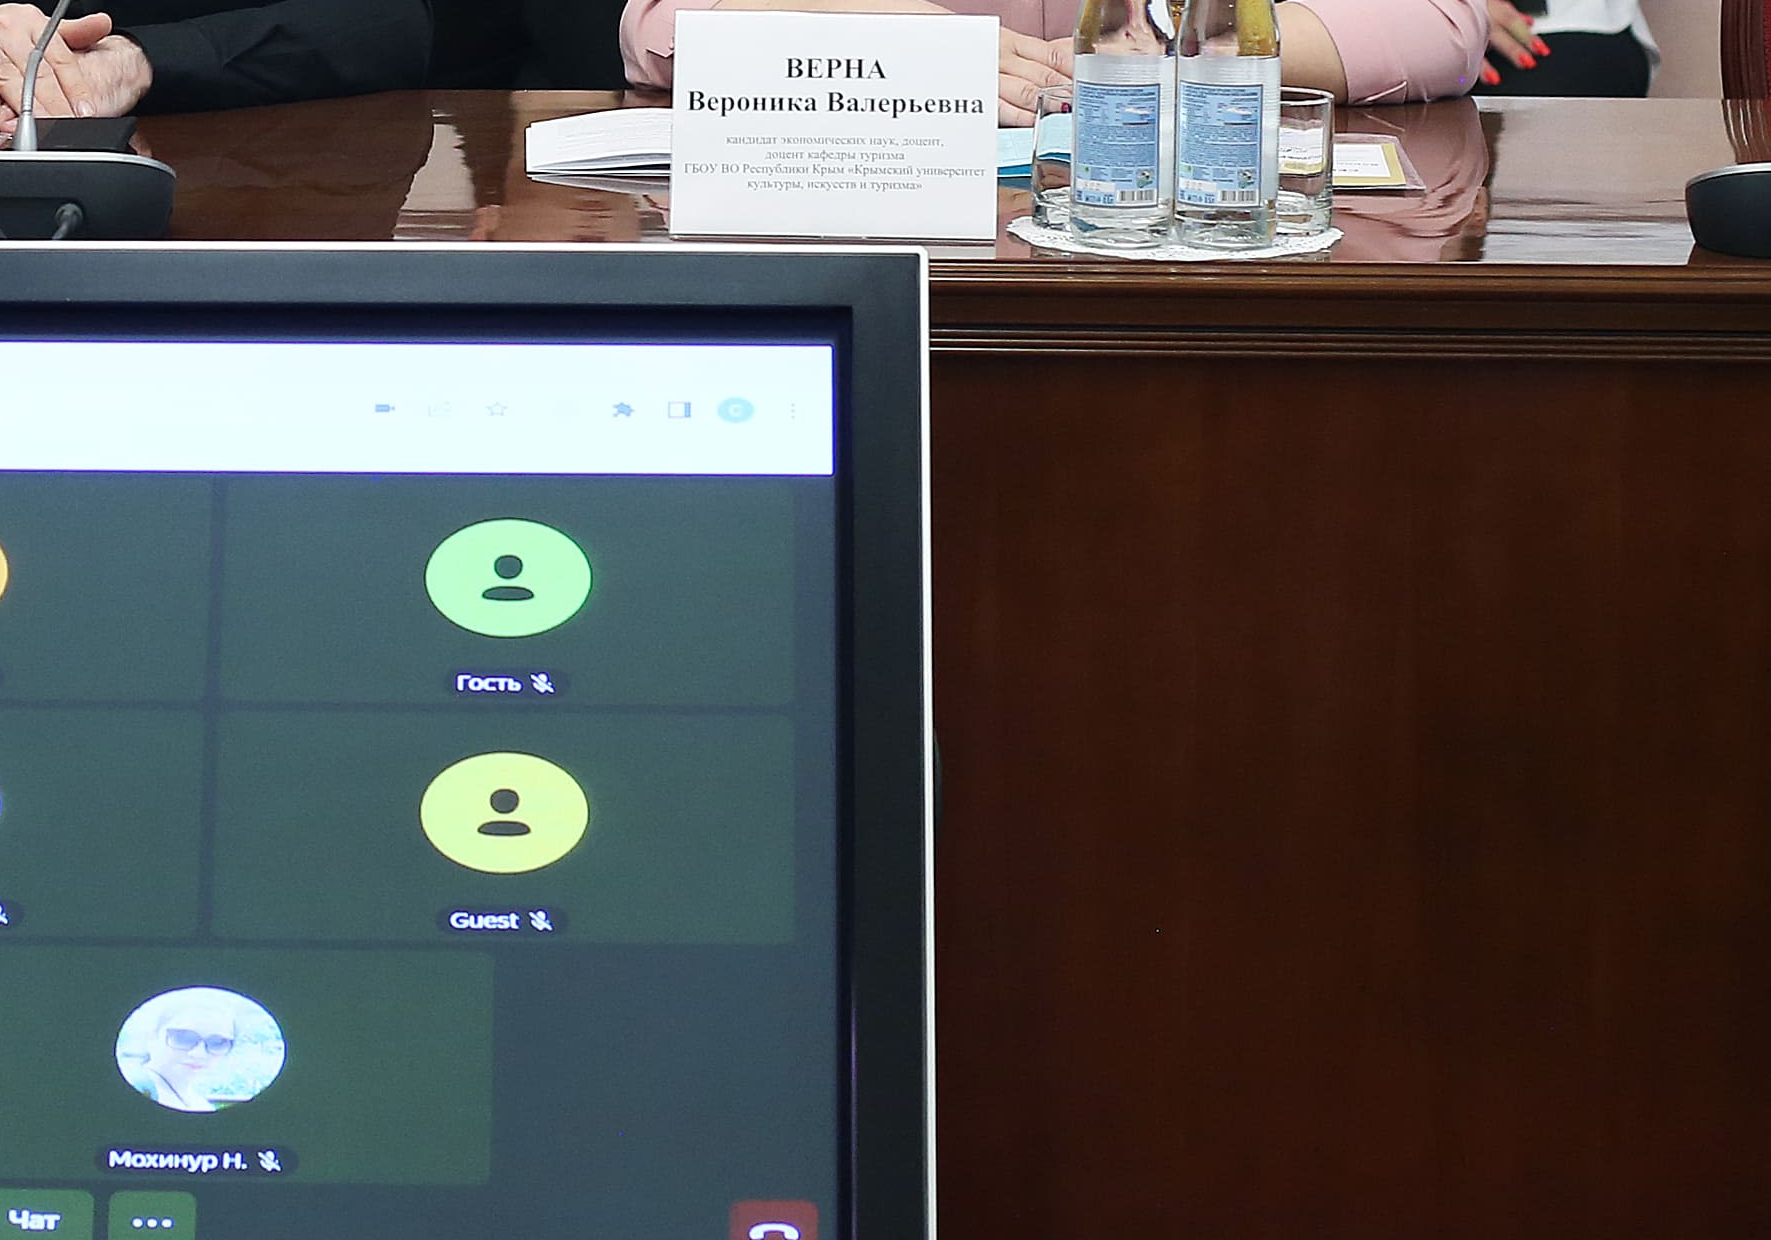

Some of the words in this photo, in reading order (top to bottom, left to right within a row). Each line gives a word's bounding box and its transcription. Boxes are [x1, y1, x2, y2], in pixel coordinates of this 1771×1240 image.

[787, 58, 886, 79] ВЕРНА
[689, 91, 816, 117] Вероника
[828, 92, 983, 118] Валерьевна
[457, 675, 521, 691] Гость
[450, 912, 519, 929] Guest
[109, 1151, 218, 1172] Мохинур
[223, 1153, 247, 1169] Н.
[9, 1210, 60, 1230] Чат
